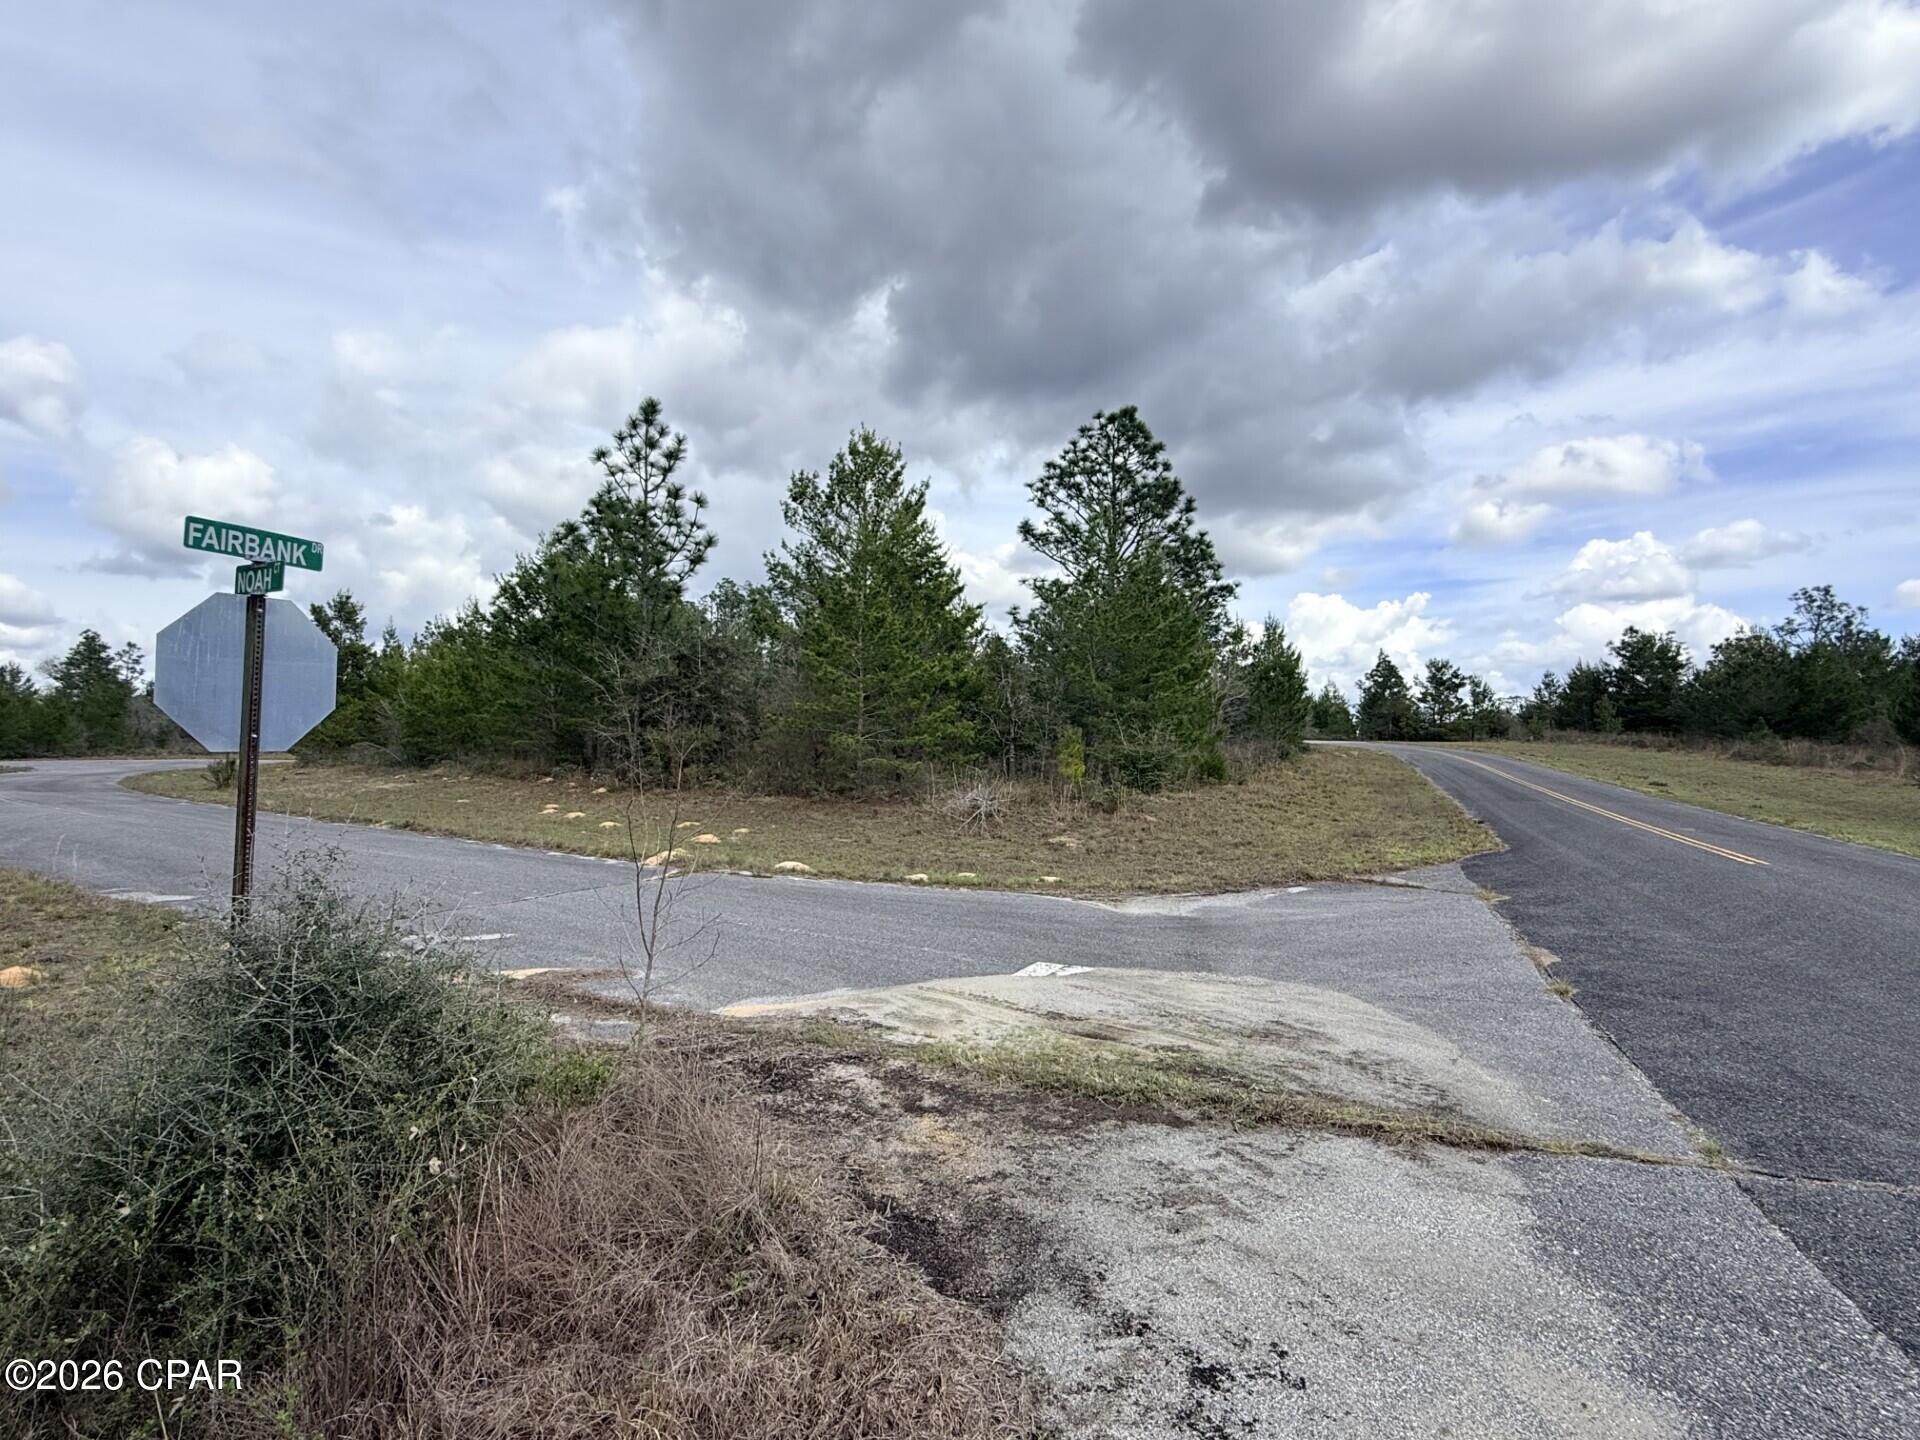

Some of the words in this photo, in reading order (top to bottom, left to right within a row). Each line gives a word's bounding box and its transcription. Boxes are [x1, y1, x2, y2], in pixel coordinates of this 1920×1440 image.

[188, 522, 308, 566] FAIRBANK
[311, 542, 324, 555] DR
[237, 568, 272, 594] NOAH
[273, 562, 281, 574] CT
